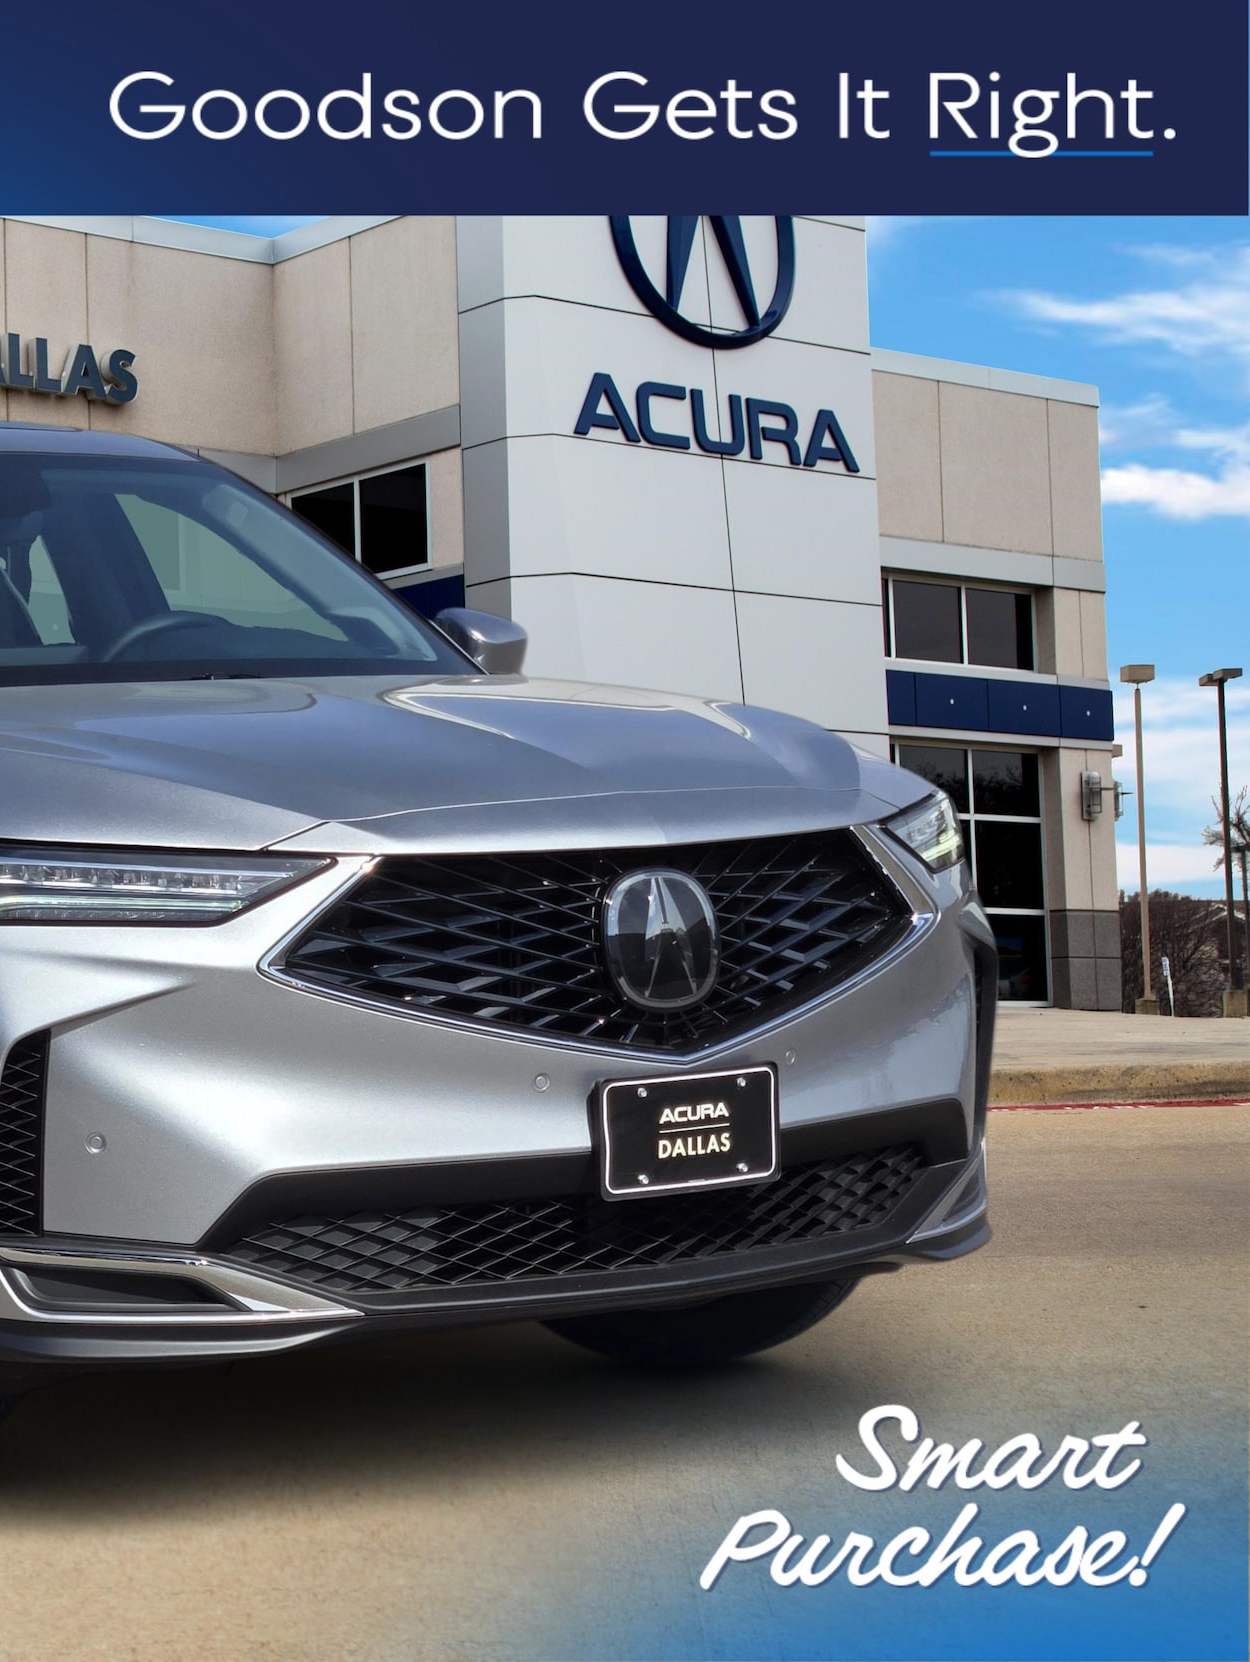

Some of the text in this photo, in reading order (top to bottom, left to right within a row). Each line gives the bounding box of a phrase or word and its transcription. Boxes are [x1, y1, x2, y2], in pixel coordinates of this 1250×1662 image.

[573, 372, 861, 474] ACURA
[658, 1102, 730, 1125] ACURA
[657, 1132, 732, 1160] DALLAS
